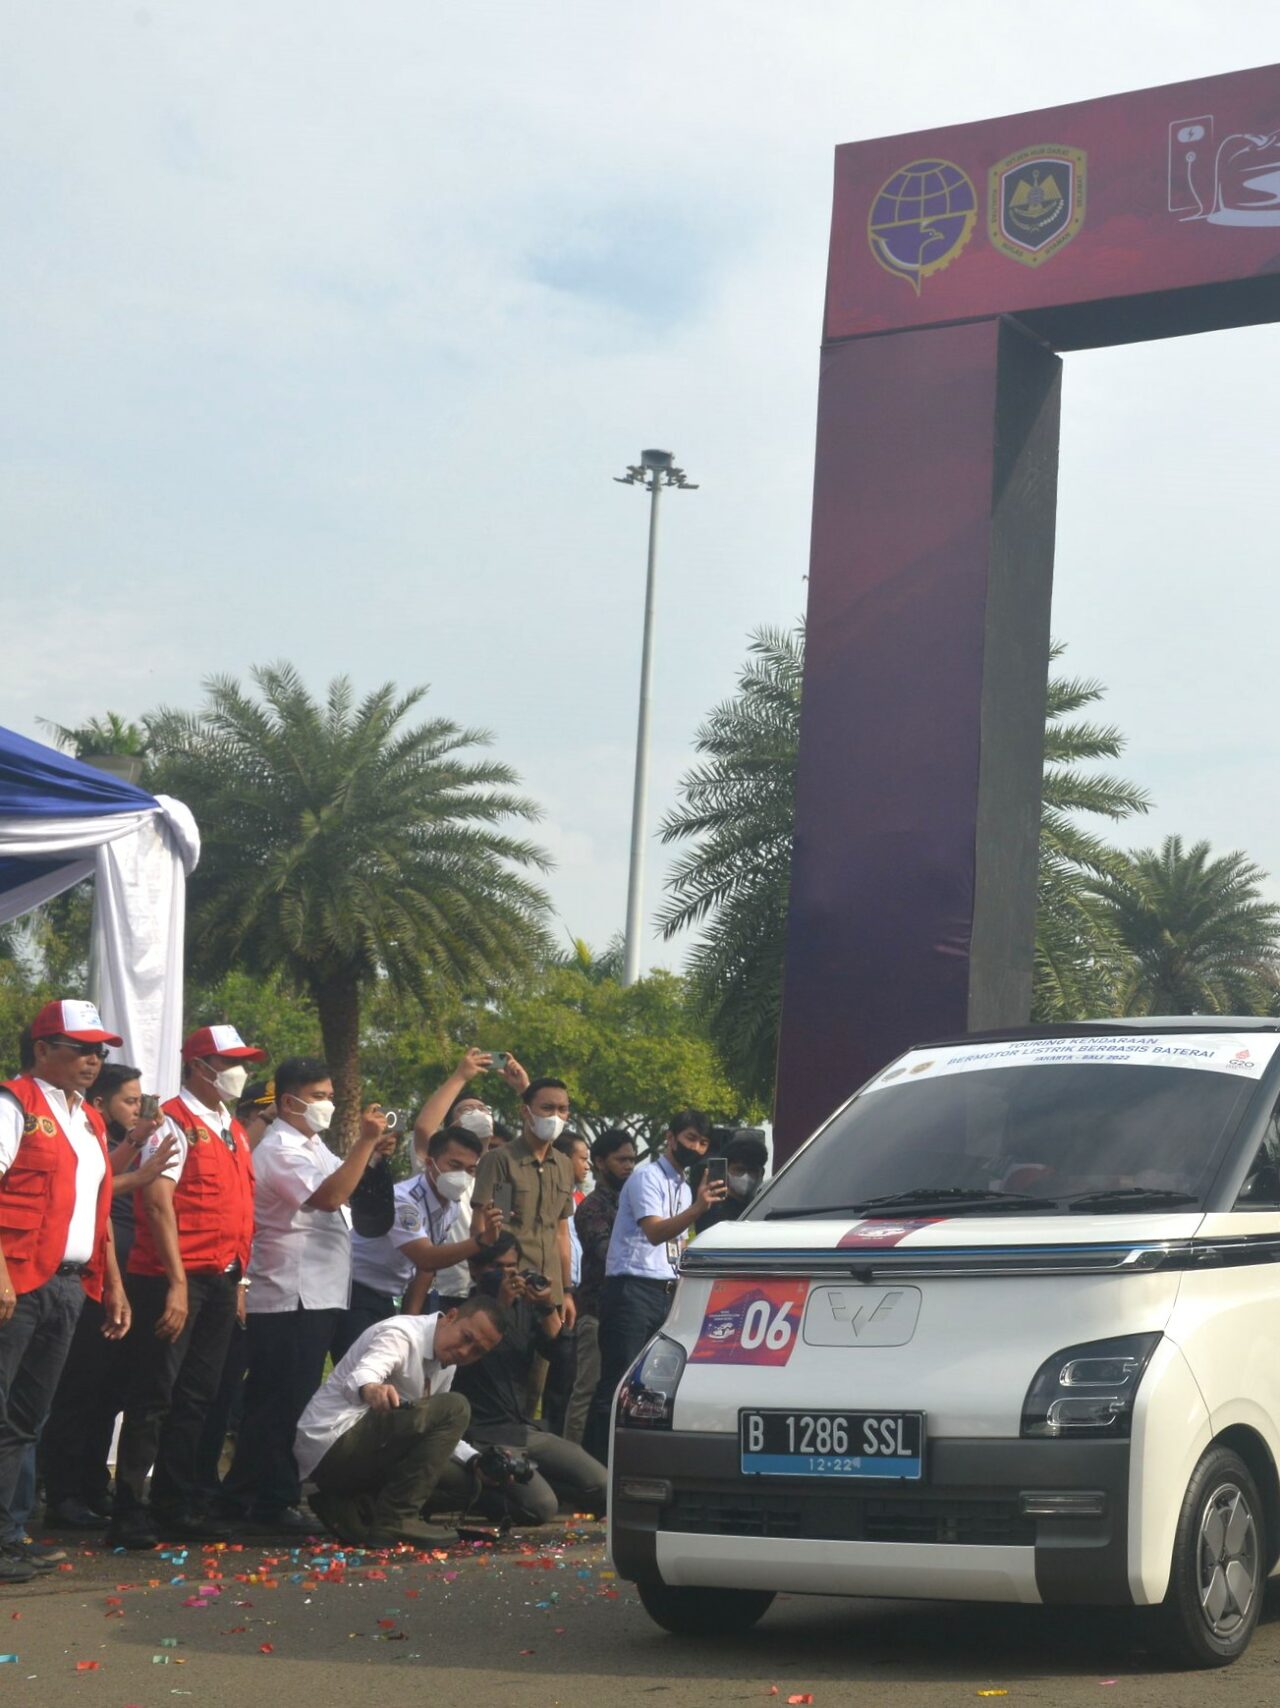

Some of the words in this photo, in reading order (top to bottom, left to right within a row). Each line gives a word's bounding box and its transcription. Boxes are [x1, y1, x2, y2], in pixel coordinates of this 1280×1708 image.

[947, 1049, 1019, 1065] BERMOTOR
[1021, 1045, 1075, 1055] LISTRIK
[1077, 1045, 1150, 1053] BERBASIS
[1152, 1047, 1215, 1058] BATERAI
[1008, 1039, 1066, 1049] TOURING
[1069, 1037, 1159, 1045] KENDARAAN
[740, 1299, 794, 1350] 06
[749, 1415, 764, 1452] B
[785, 1416, 849, 1454] 1286
[862, 1418, 913, 1456] SSL
